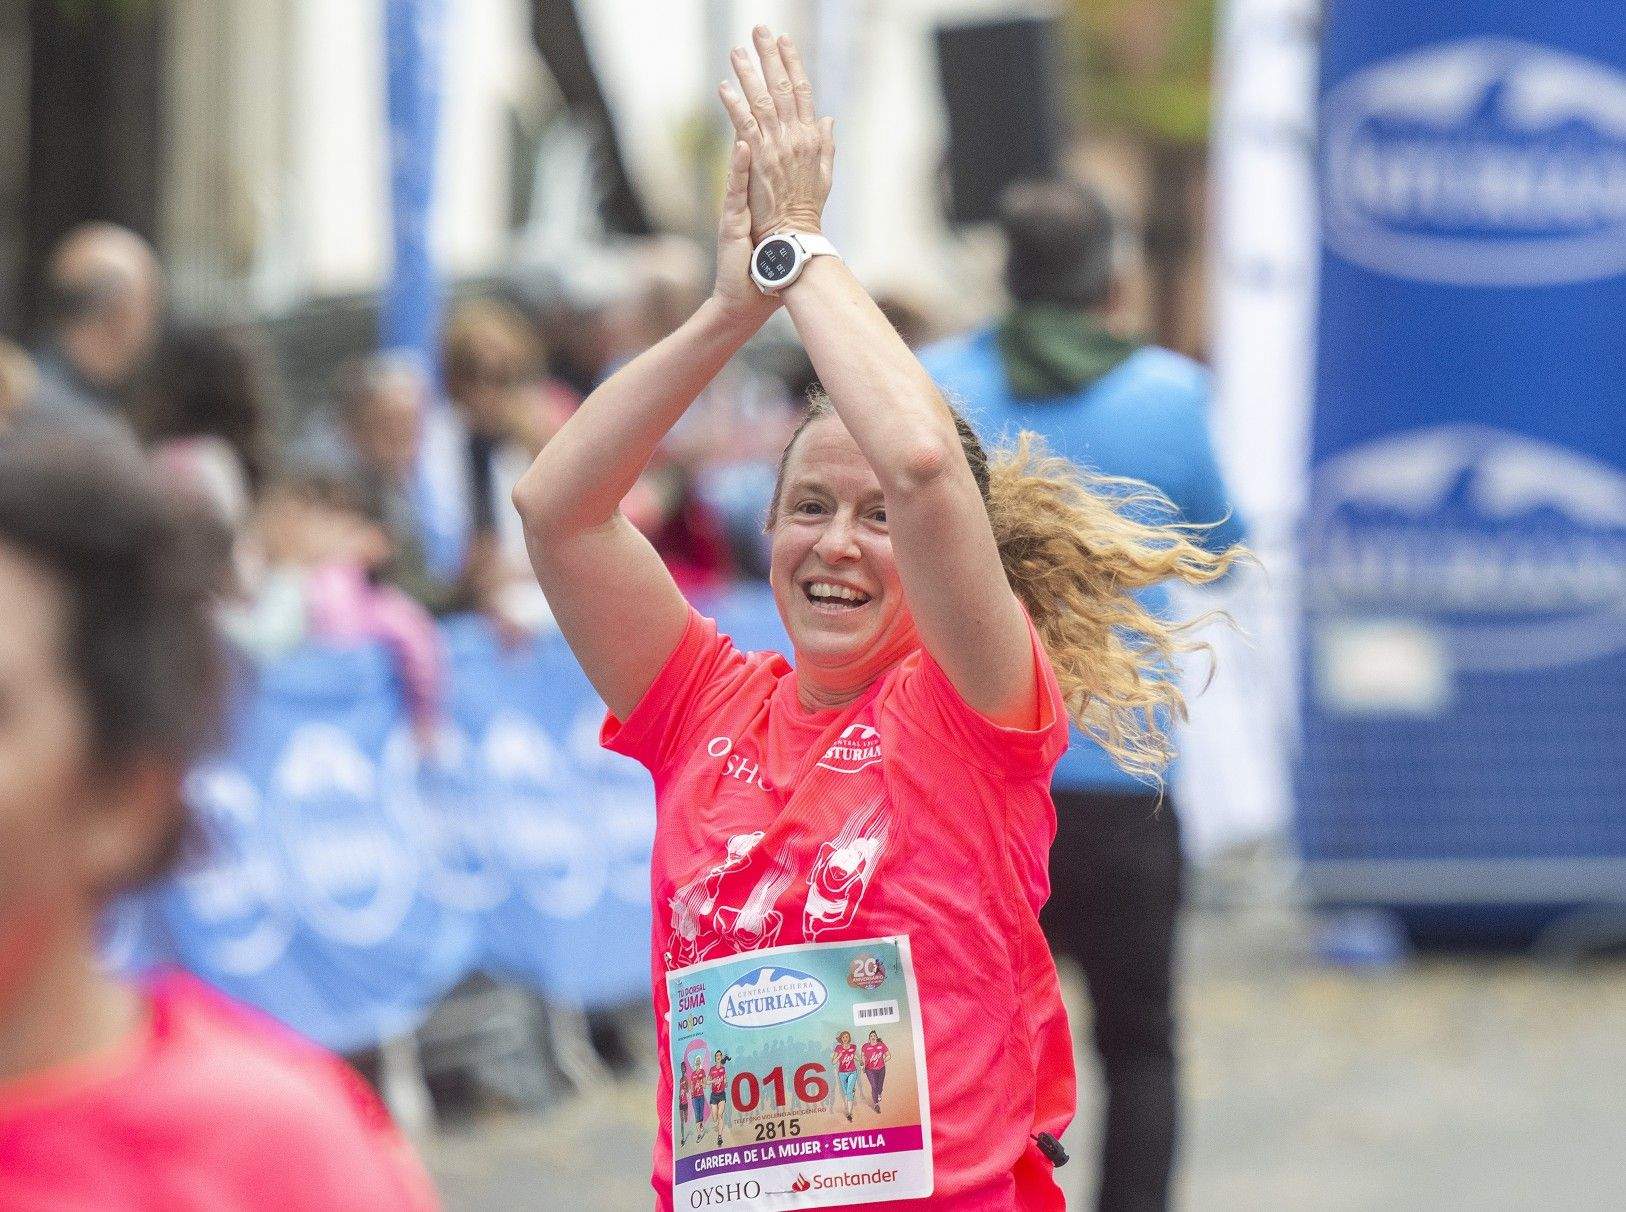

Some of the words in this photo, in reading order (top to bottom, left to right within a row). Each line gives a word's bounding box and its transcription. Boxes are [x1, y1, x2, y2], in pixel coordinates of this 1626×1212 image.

[853, 957, 878, 978] 20
[685, 982, 706, 995] DORSAL
[737, 986, 770, 998] CENTRAL
[773, 981, 813, 992] LECHERA
[678, 992, 706, 1013] SUMA
[731, 1062, 829, 1113] 016
[754, 1118, 801, 1141] 2815
[694, 1151, 741, 1172] CARRERA
[743, 1148, 759, 1163] DE
[761, 1147, 776, 1160] LA
[778, 1140, 822, 1158] MUJER
[832, 1133, 886, 1152] SEVILLA
[813, 1169, 898, 1190] Santander
[690, 1180, 761, 1209] OYSHO
